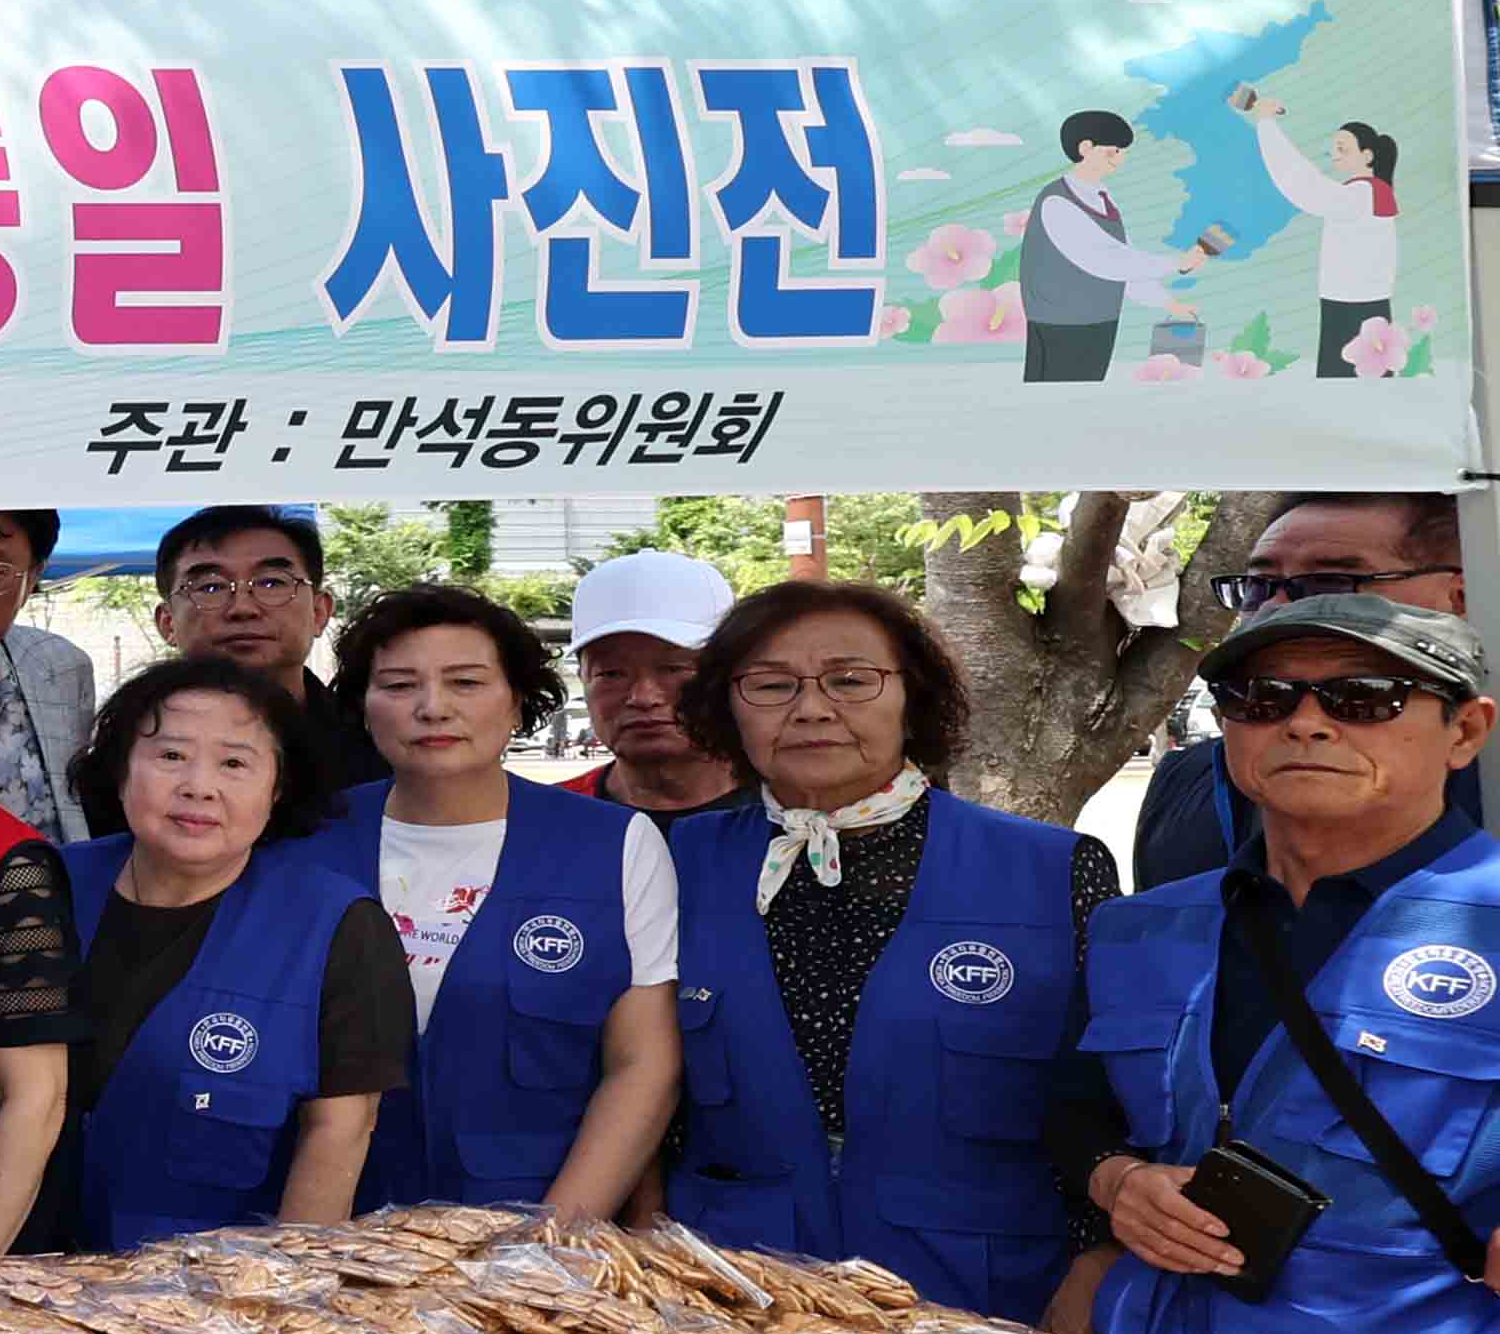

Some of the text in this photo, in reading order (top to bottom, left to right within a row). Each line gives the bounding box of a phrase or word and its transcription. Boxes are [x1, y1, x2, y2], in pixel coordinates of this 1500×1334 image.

[324, 67, 879, 344] 사진전
[86, 397, 249, 476] 주관
[334, 390, 785, 471] 만석동위원회
[420, 929, 460, 945] WORLD
[529, 935, 572, 954] KFF
[948, 964, 997, 984] KFF
[1407, 970, 1472, 995] KFF
[203, 1032, 245, 1055] KFF
